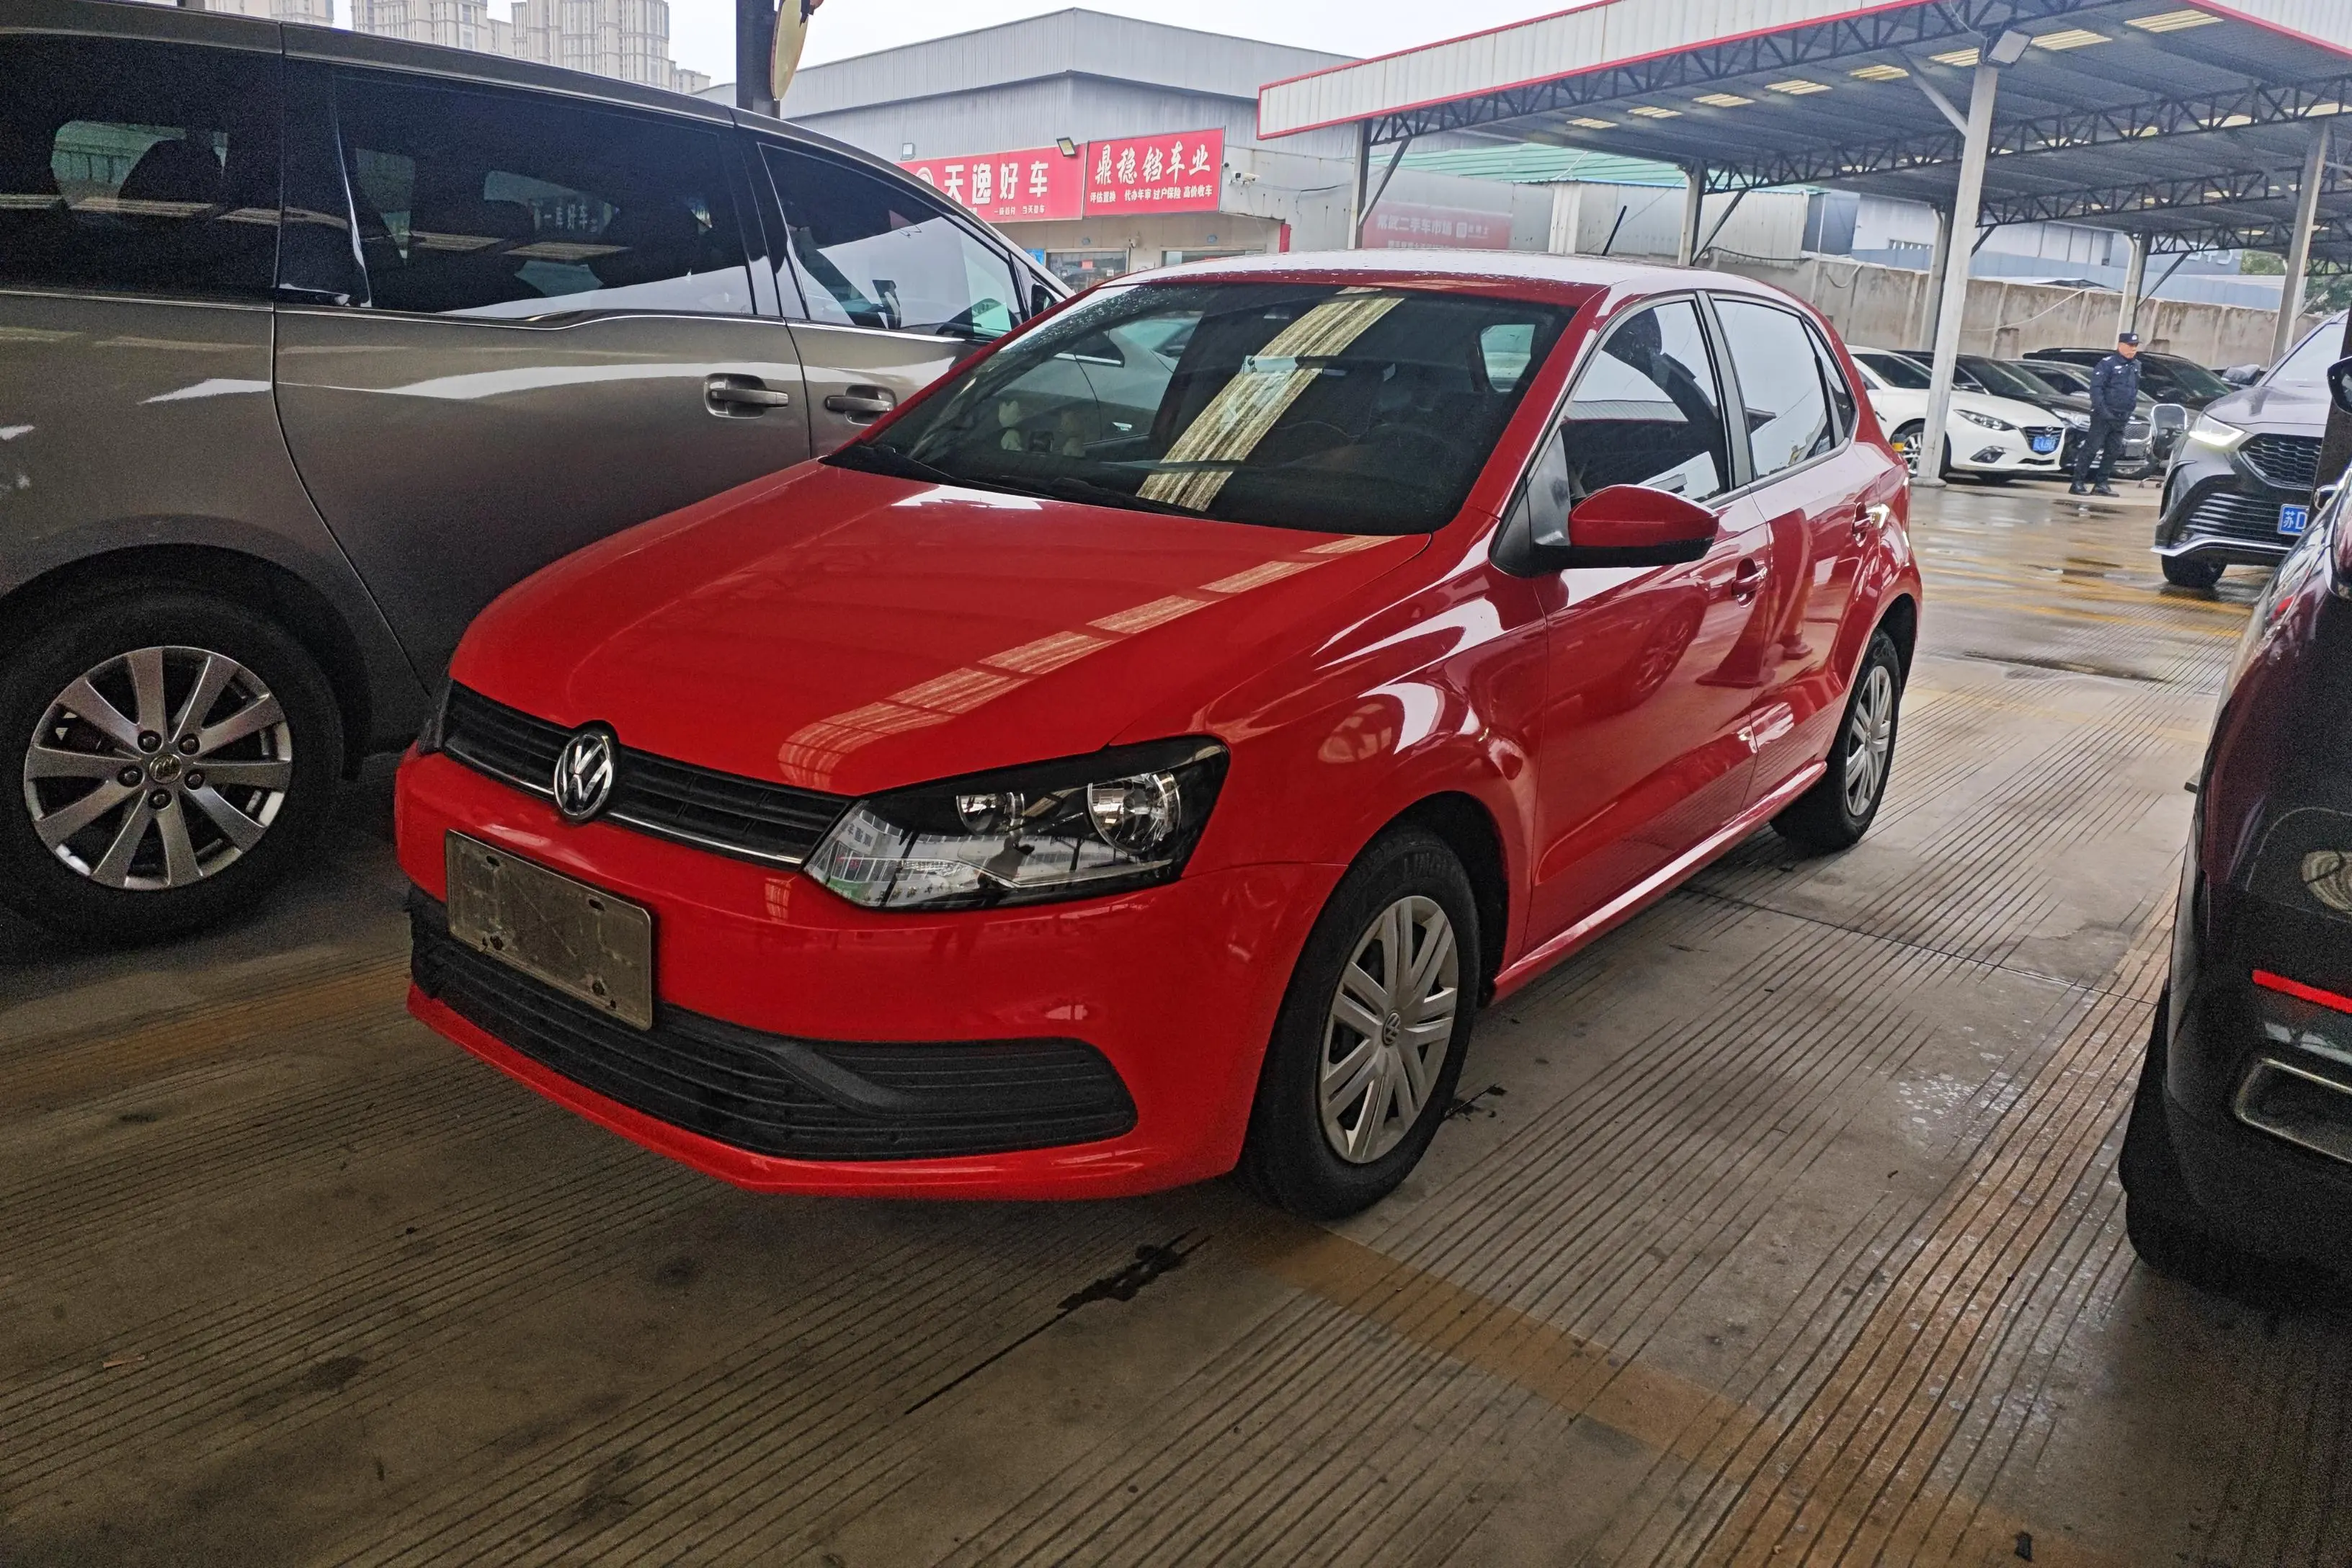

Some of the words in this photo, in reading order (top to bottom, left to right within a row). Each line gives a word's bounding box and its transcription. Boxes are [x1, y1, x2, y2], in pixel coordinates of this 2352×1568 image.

[944, 161, 1048, 205] 天逸好车
[1090, 191, 1116, 203] 评估置换
[1124, 188, 1152, 202] 代办年审
[1153, 187, 1181, 200] 过户保险
[1183, 185, 1213, 198] 高价收车
